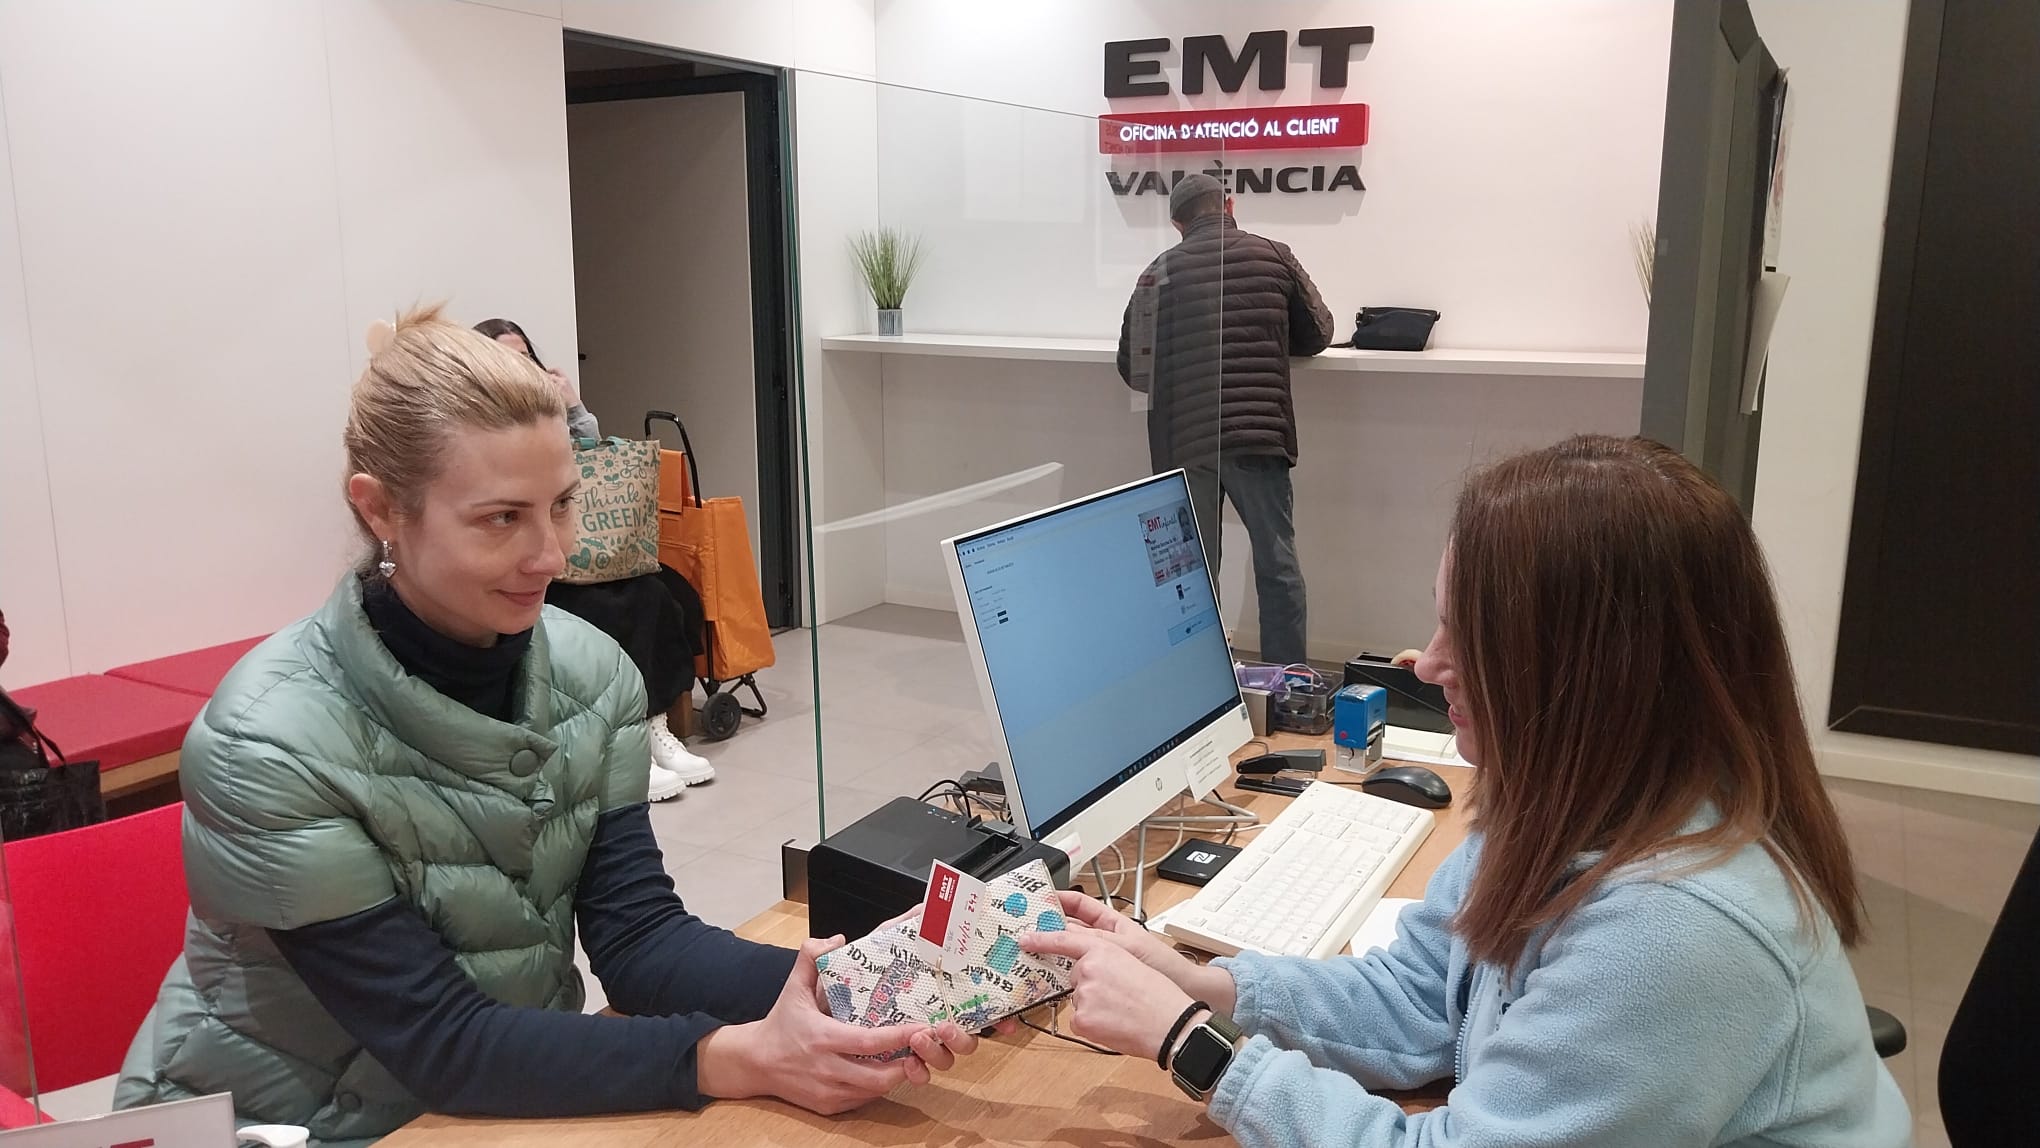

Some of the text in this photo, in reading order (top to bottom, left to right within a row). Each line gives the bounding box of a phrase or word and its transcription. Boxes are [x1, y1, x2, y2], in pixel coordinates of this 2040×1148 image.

[1104, 26, 1374, 98] EMT
[1119, 125, 1177, 142] OFICINA
[1180, 117, 1259, 140] D'ATENCIÓ
[1263, 120, 1282, 137] AL
[1286, 117, 1339, 136] CLIENT
[574, 482, 641, 513] Think
[582, 507, 641, 533] GREEN
[1147, 516, 1161, 532] EMT
[938, 874, 949, 900] EMT
